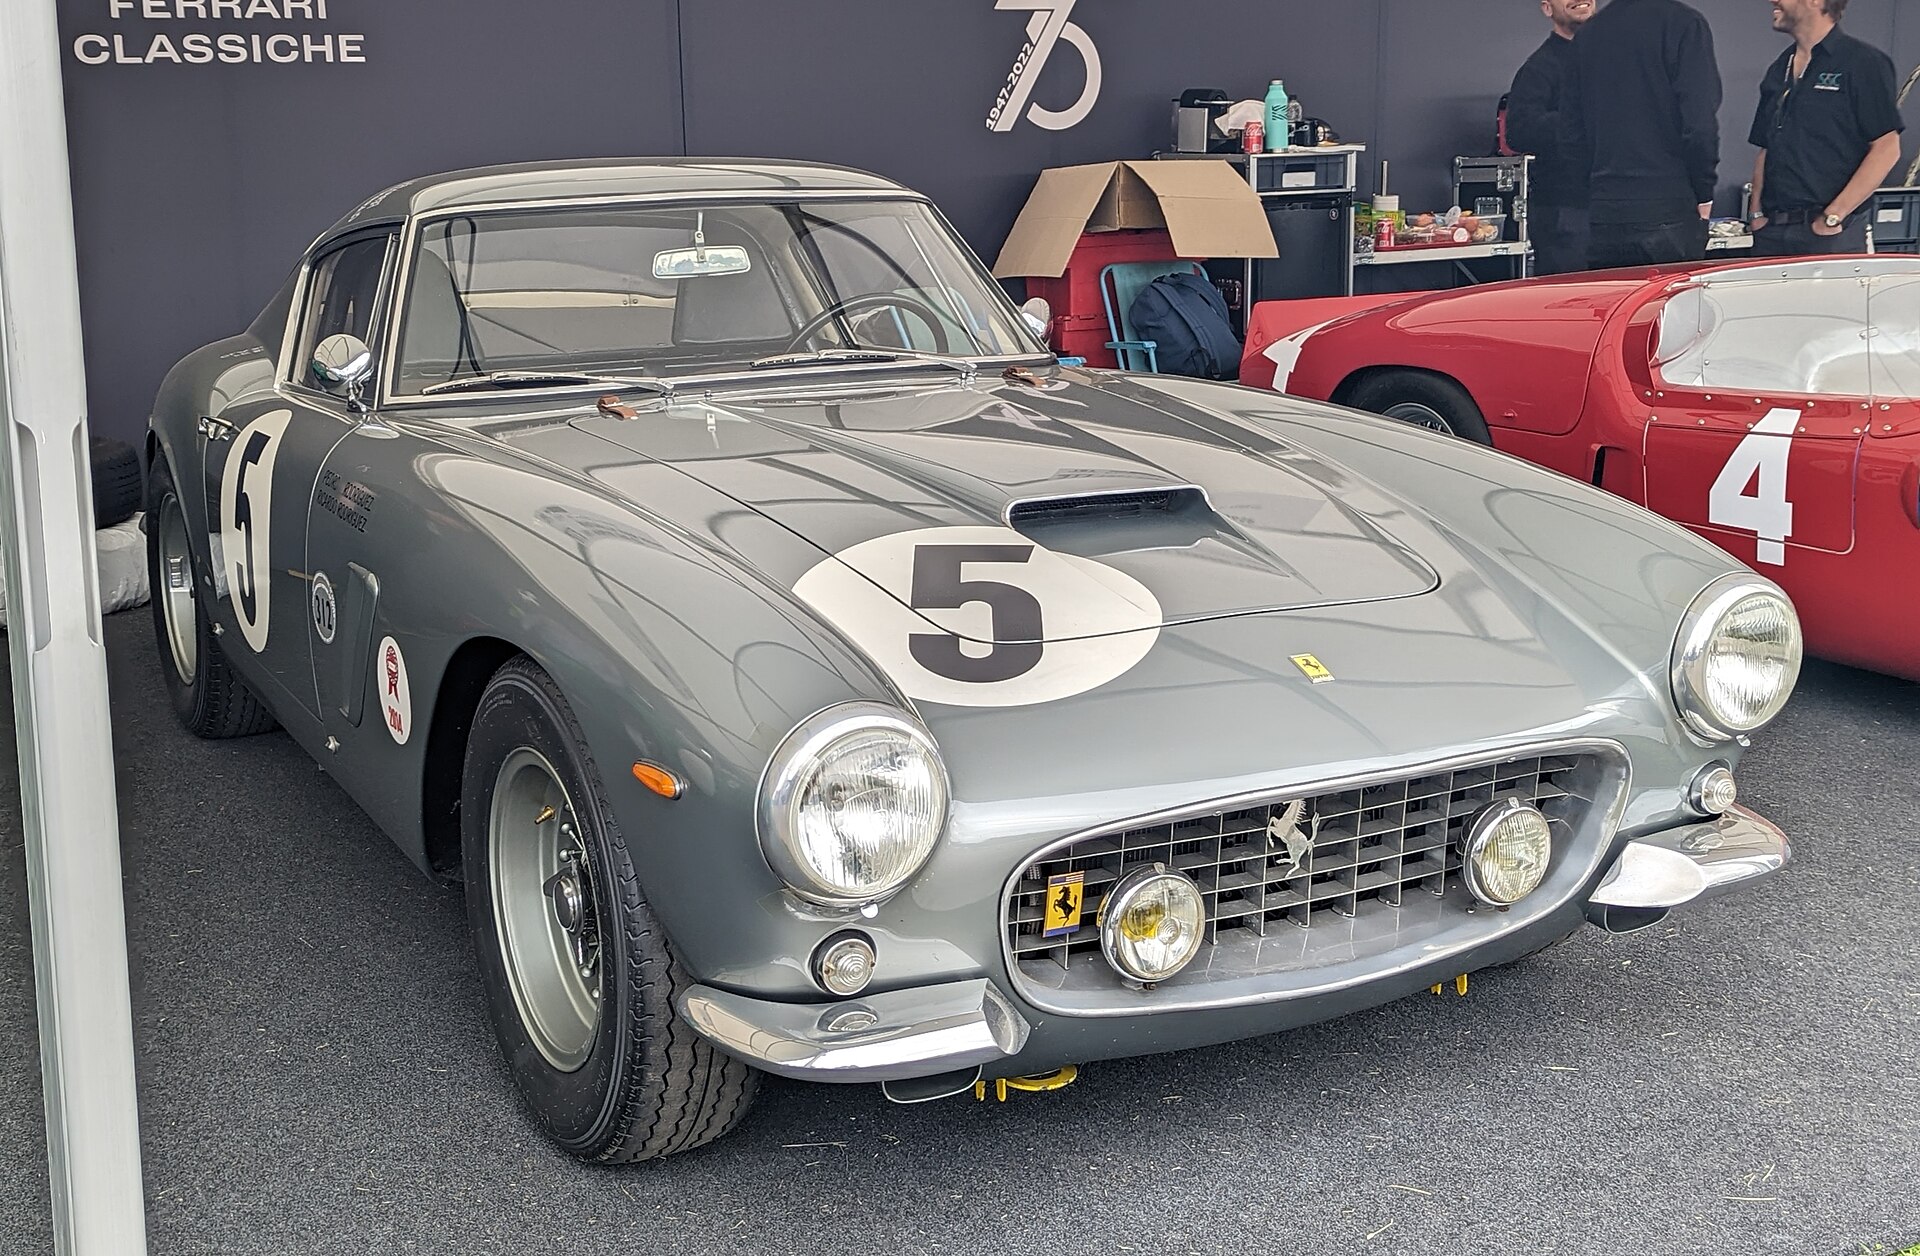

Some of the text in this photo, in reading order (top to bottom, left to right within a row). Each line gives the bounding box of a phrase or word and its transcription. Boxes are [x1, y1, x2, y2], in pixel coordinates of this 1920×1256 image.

[110, 0, 327, 19] FERRARI
[73, 34, 366, 64] CLASSICHE
[985, 42, 1034, 131] 1947-2022
[337, 502, 368, 533] RODRIGUEZ
[1709, 407, 1802, 566] 4
[235, 430, 271, 627] 5
[316, 594, 333, 631] 312
[909, 544, 1044, 683] 5
